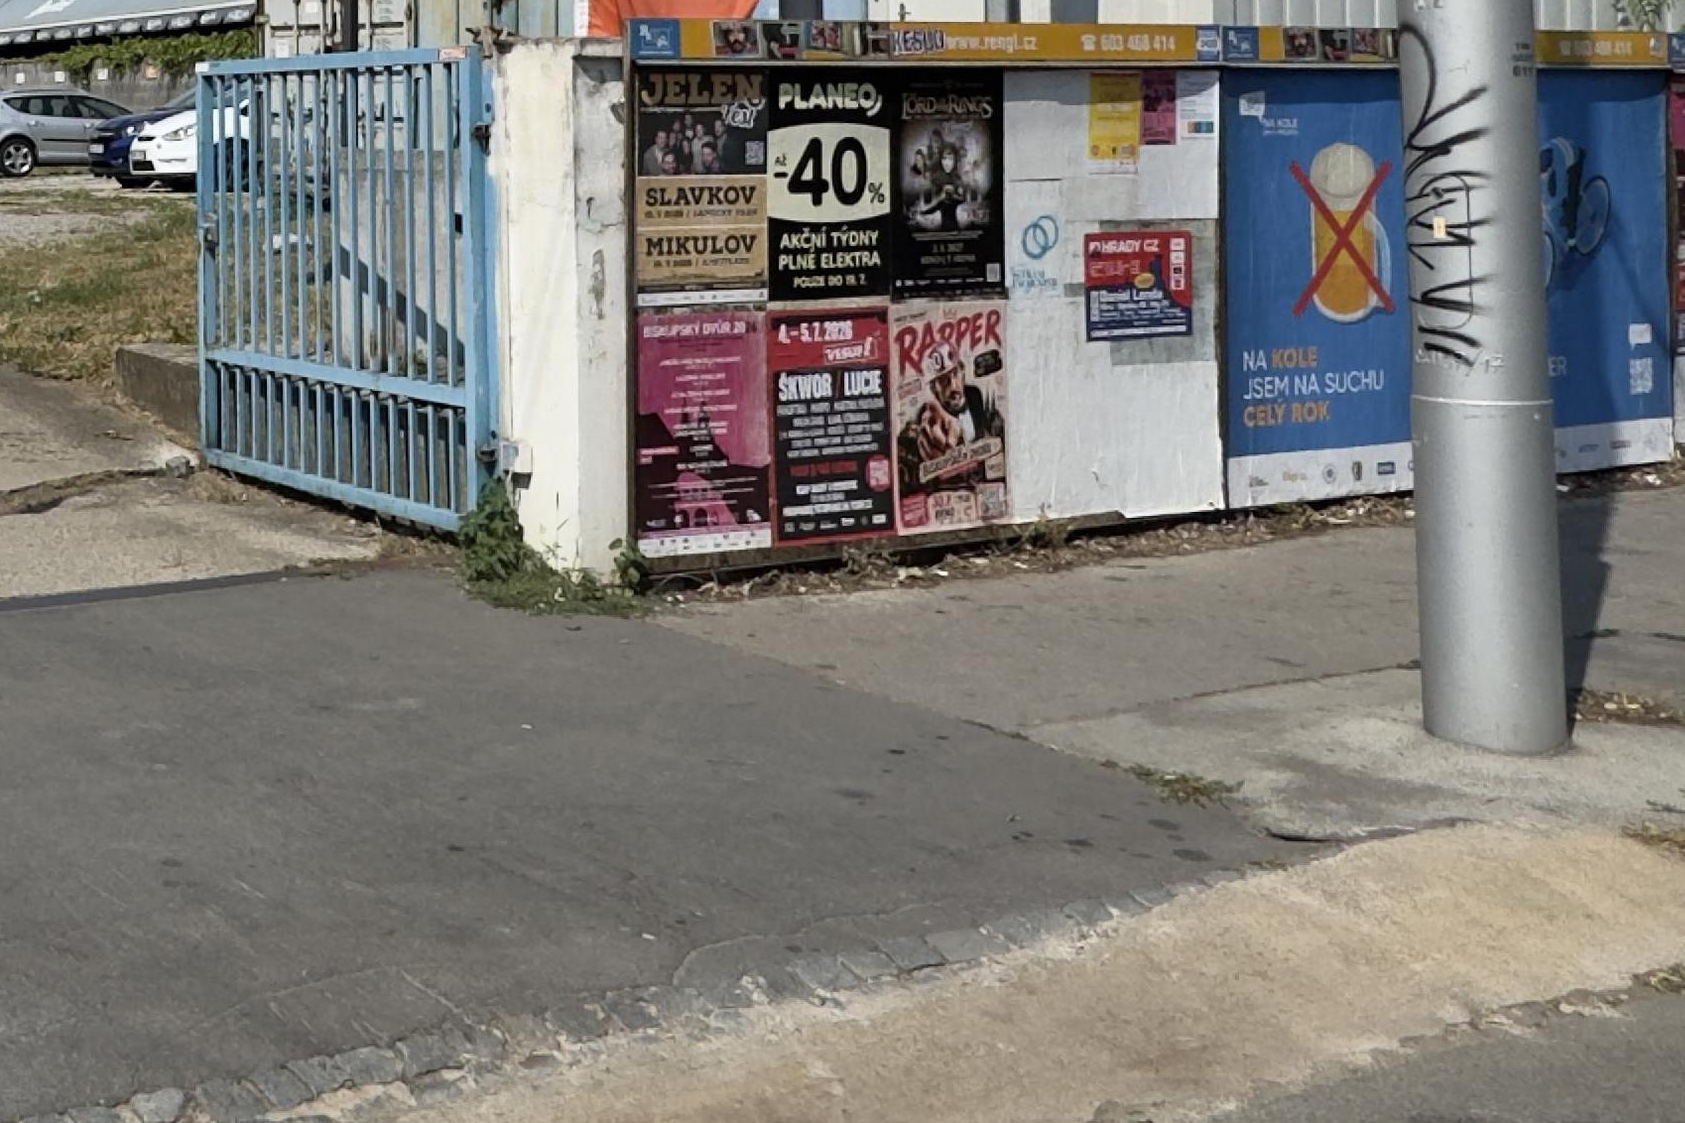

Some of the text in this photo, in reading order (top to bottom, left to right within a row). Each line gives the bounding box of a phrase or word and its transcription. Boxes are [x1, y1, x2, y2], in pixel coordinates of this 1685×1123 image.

[1153, 33, 1176, 51] 414
[641, 73, 764, 105] JELEN
[778, 83, 878, 111] PLANEO
[645, 185, 757, 207] SLAVKOV
[645, 234, 758, 257] MIKULOV
[831, 224, 880, 246] TÝDNY
[820, 251, 881, 269] ELEKTRA
[894, 308, 1003, 378] RAPPER
[1242, 345, 1319, 373] NA KOLE
[1243, 368, 1385, 400] JSEM NA SUCHU
[1242, 398, 1331, 427] CELÝ ROK
